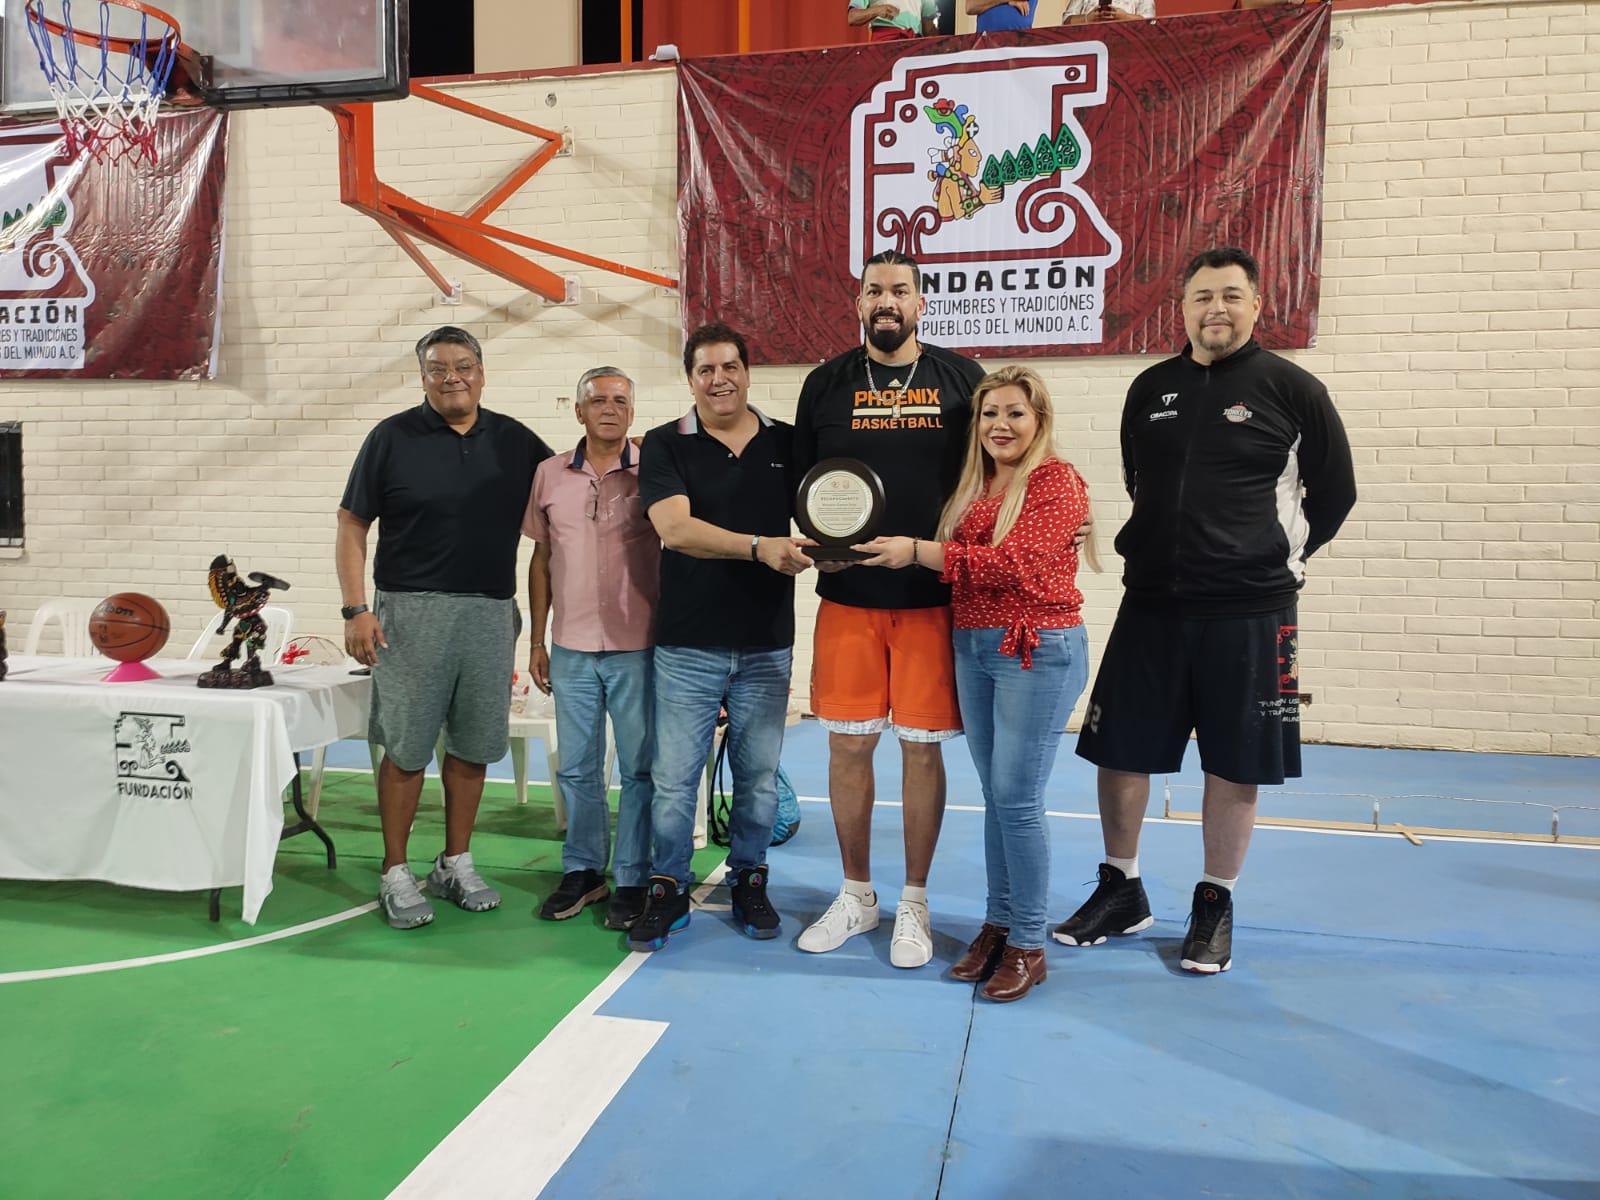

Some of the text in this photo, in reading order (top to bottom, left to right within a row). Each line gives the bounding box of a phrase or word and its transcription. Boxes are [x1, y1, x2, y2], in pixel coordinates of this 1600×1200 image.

[922, 260, 1095, 294] NDACIÓN
[0, 300, 78, 324] ACIÓN
[999, 297, 1008, 313] Y
[1011, 292, 1095, 313] TRADICIÓNES
[13, 328, 20, 343] Y
[22, 326, 79, 343] TRADICIÓNES
[922, 315, 1093, 337] PUEBLOS DEL MUNDO A.C.
[4, 345, 22, 360] DEL
[24, 345, 57, 360] MUNDO
[854, 388, 941, 407] PHOENIX
[851, 417, 944, 430] BASKETBALL
[118, 782, 193, 800] FUNDACIÓN
